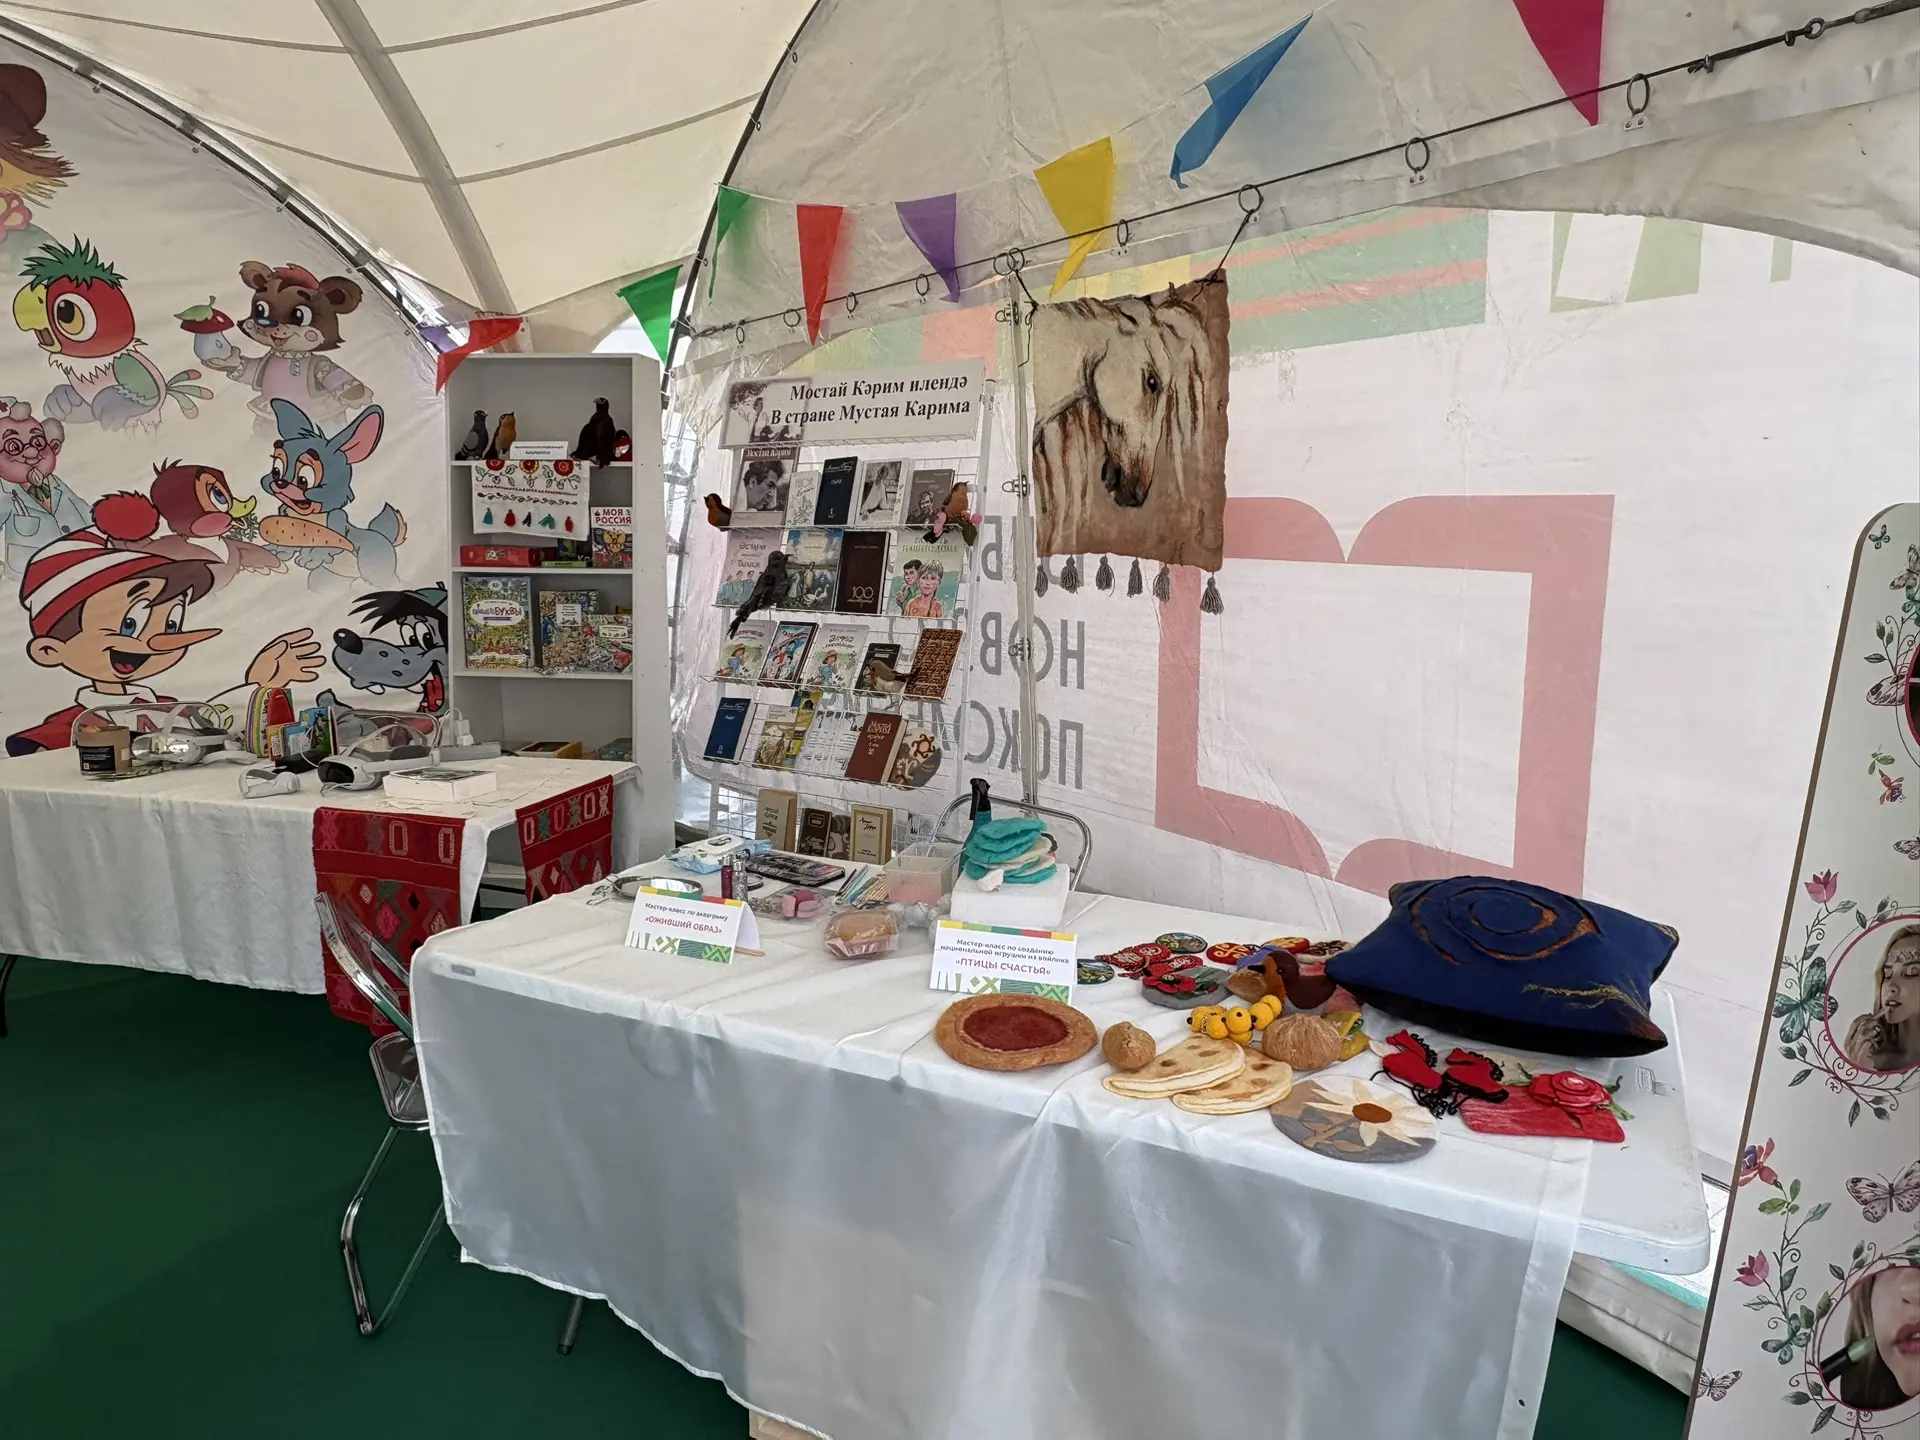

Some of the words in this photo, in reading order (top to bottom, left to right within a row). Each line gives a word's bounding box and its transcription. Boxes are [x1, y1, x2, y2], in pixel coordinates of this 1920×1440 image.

[789, 381, 847, 400] Мостай
[851, 380, 904, 398] Кәрим
[909, 375, 967, 393] илендә
[771, 409, 781, 424] В
[784, 409, 835, 427] стране
[839, 404, 899, 423] Мустая
[904, 399, 970, 420] Карима
[595, 516, 632, 525] РОССИЯ
[602, 508, 624, 517] МОЯ
[645, 902, 686, 915] Мастер-класс
[696, 911, 728, 922] аквагриму
[645, 915, 692, 929] «ОЖИВШИЙ
[693, 923, 722, 934] ОБРАЗ»
[940, 945, 993, 956] национальной
[994, 950, 1027, 960] игрушки
[1038, 955, 1070, 964] войлока
[957, 939, 1005, 950] Мастер-класс
[1018, 946, 1054, 956] созданию
[955, 957, 998, 970] «ПТИЦЫ
[1000, 963, 1051, 976] СЧАСТЬЯ»
